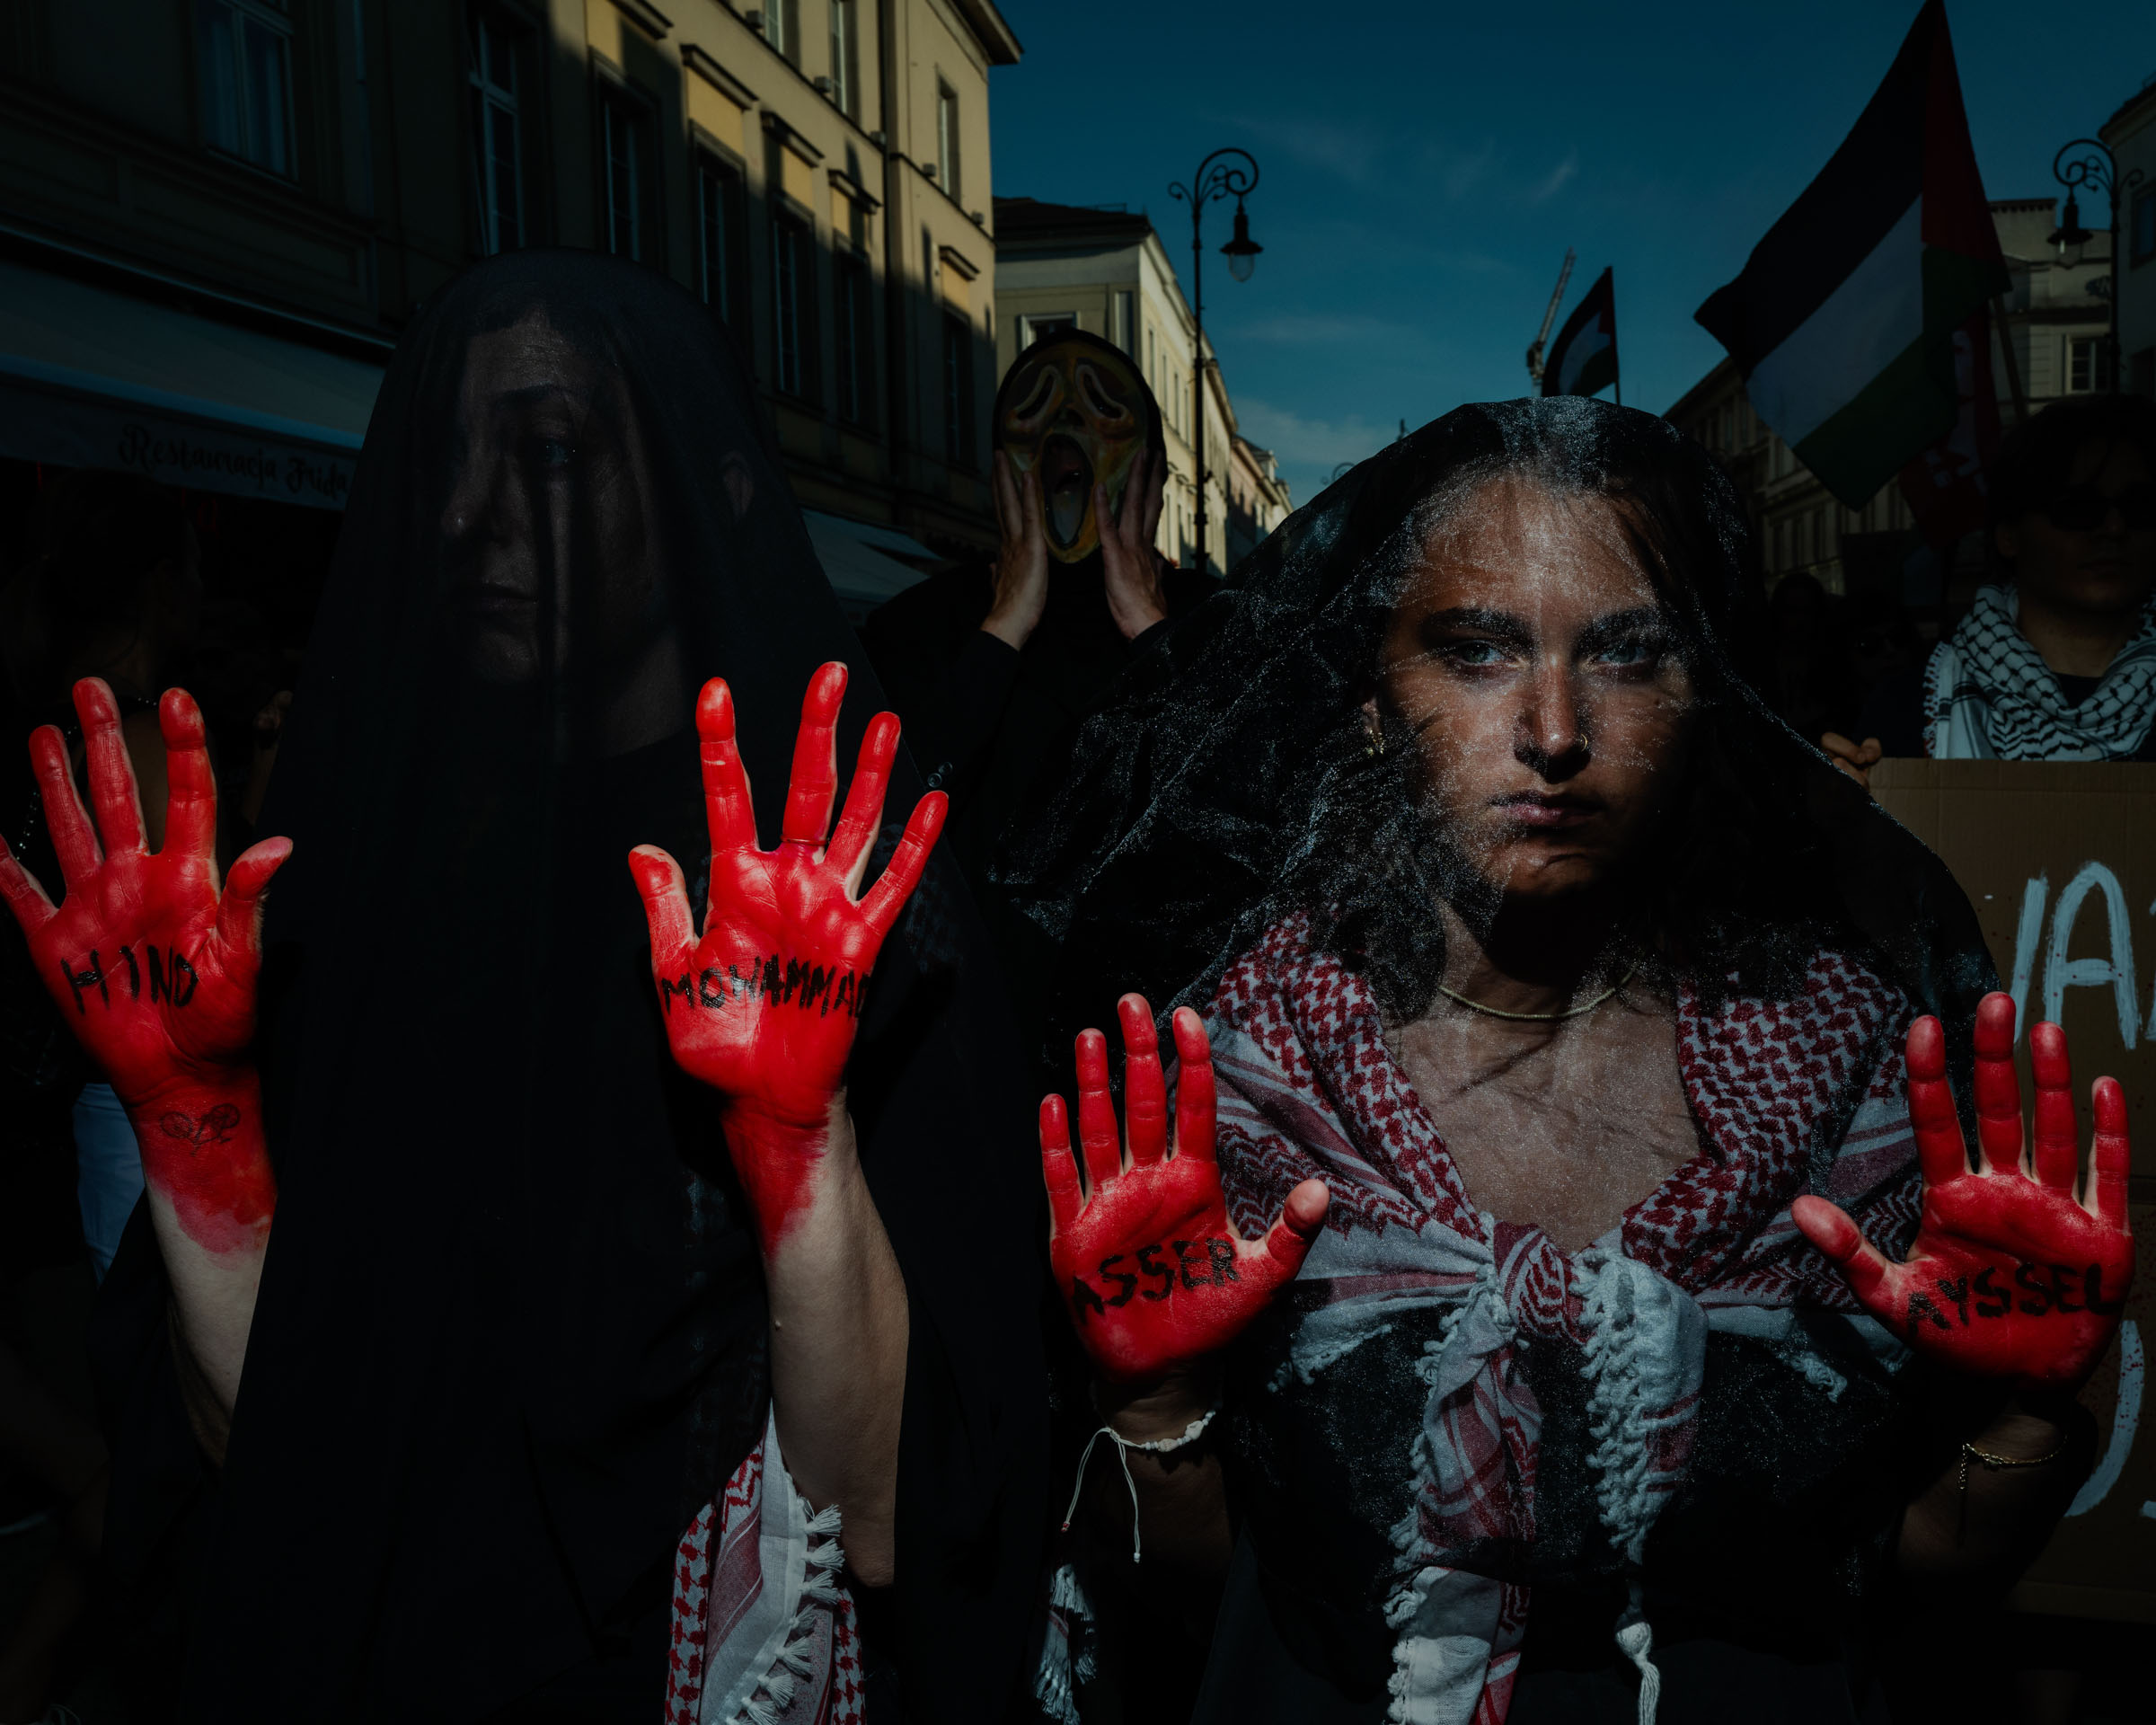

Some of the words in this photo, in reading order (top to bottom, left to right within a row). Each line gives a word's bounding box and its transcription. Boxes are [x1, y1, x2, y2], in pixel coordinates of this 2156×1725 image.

[119, 423, 276, 490] Restauracja
[286, 456, 348, 500] Frida
[60, 945, 199, 1014] HIND
[1073, 1237, 1240, 1328] ASSER
[1907, 1261, 2123, 1341] AYSSEL
